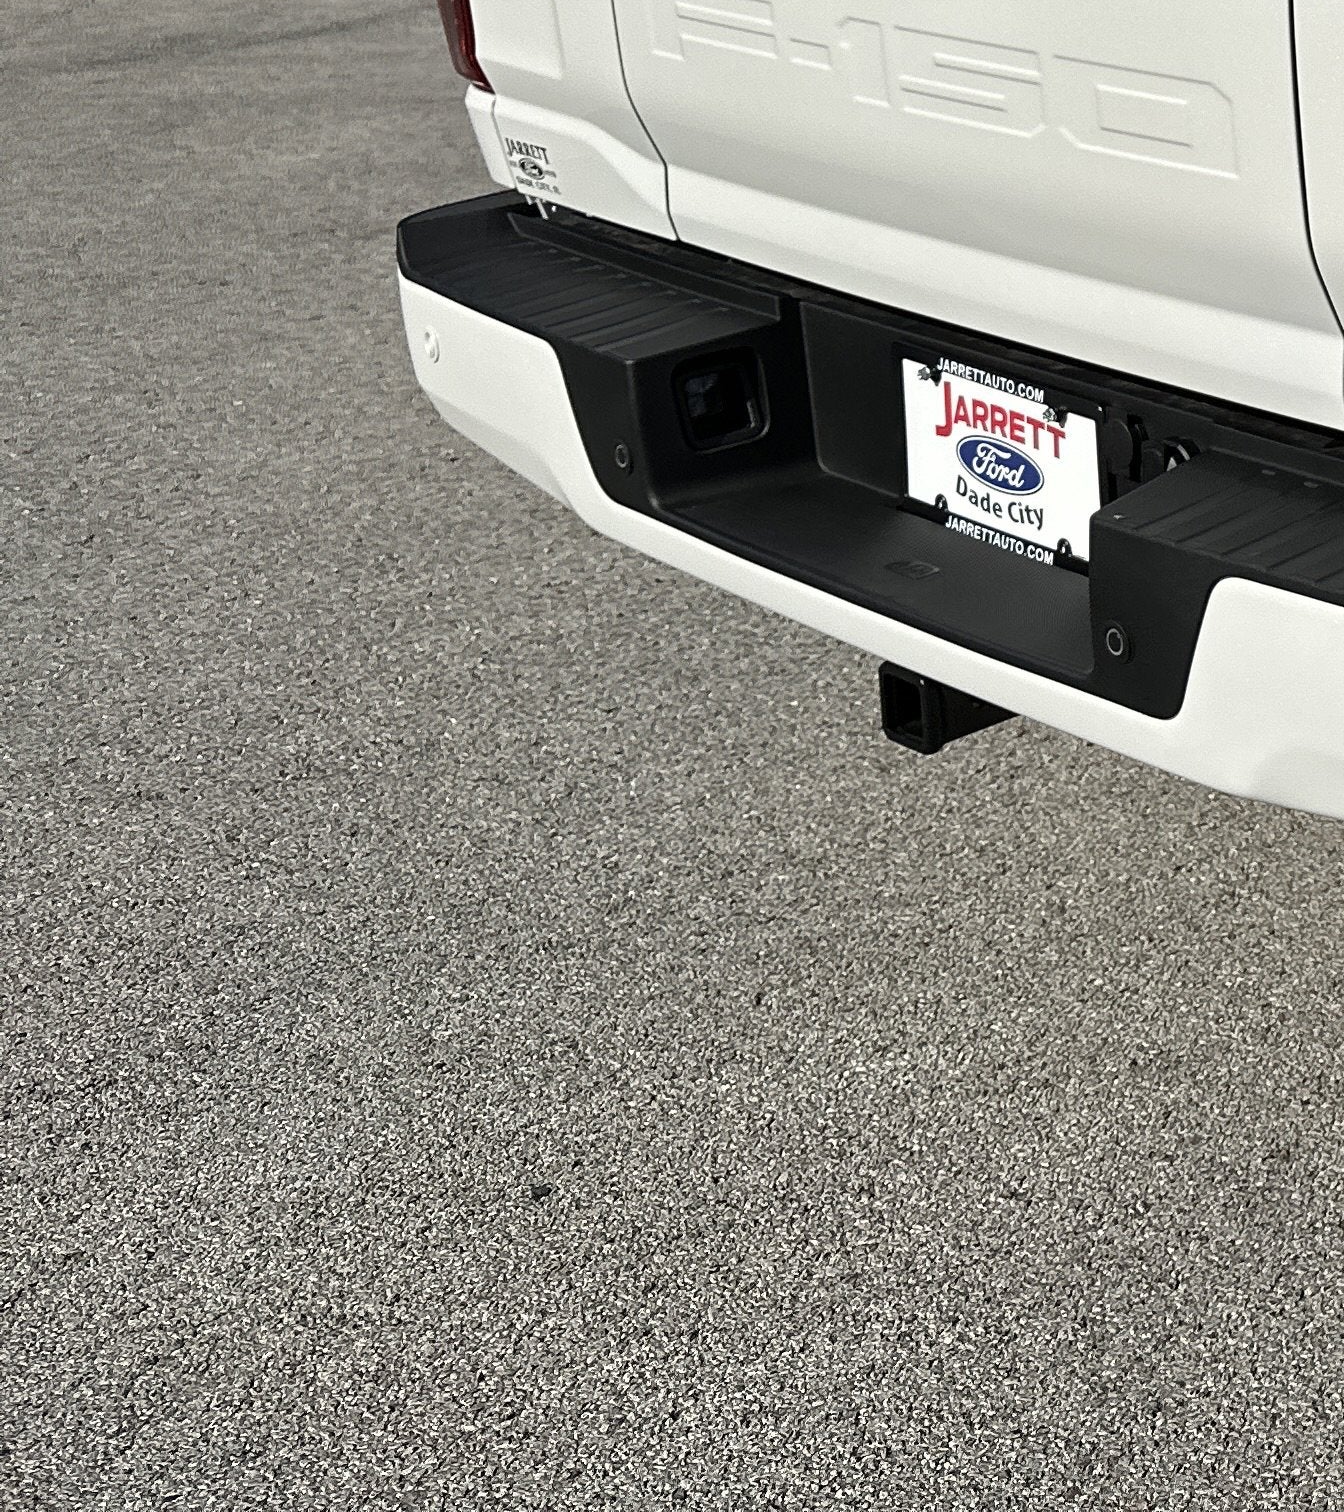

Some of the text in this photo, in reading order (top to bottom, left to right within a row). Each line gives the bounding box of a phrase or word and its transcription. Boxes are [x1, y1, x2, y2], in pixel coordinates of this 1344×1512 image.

[505, 137, 549, 164] JARRETT
[937, 357, 1044, 403] JARRETTAUTO.COM
[935, 381, 1066, 459] JARRETT
[972, 443, 1025, 489] Ford
[955, 475, 1044, 531] Dade City
[945, 515, 1054, 566] JARRETTAUTO.COM
